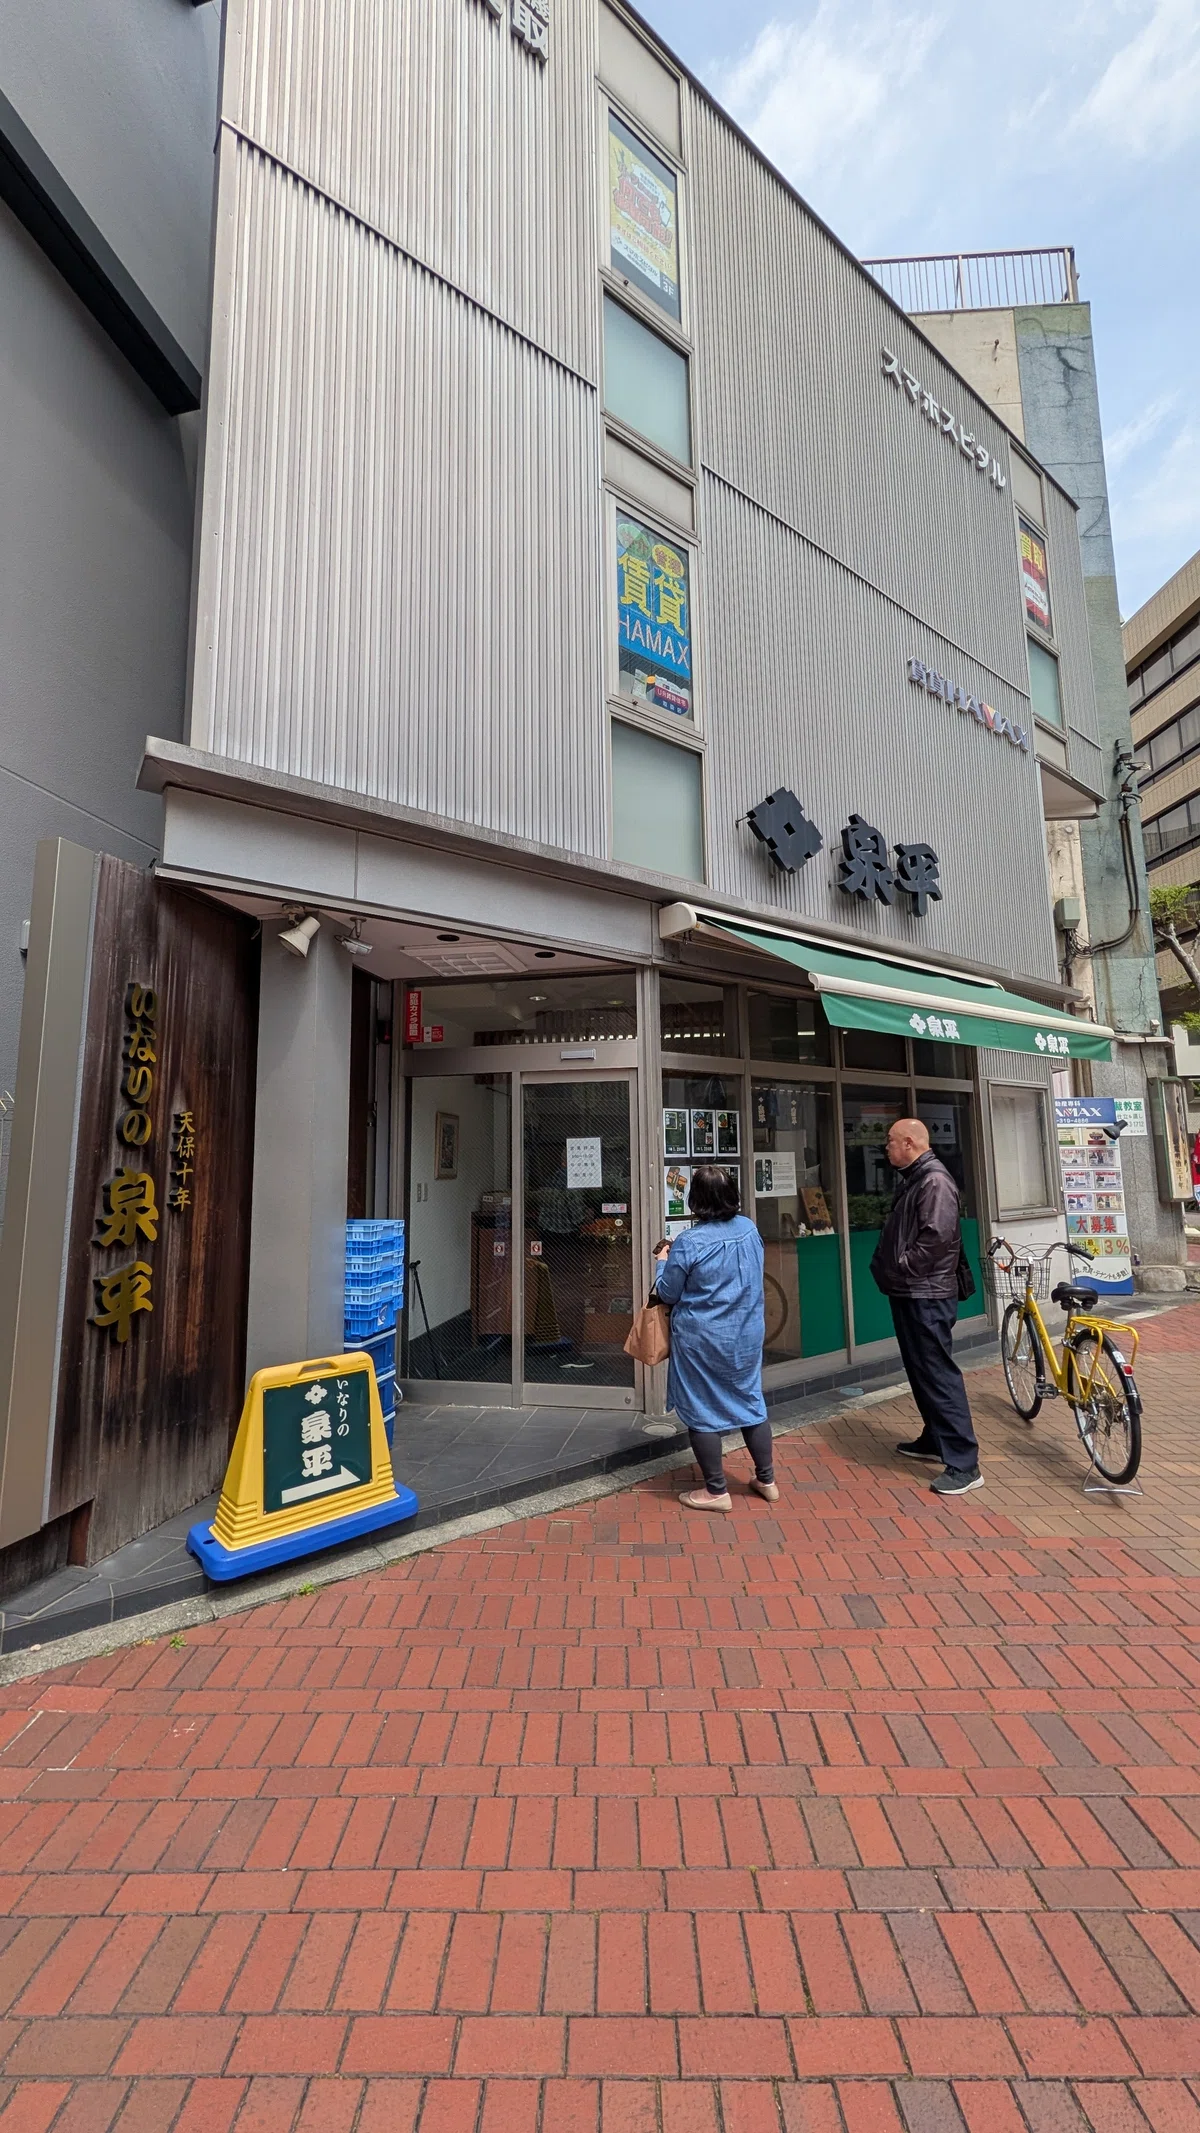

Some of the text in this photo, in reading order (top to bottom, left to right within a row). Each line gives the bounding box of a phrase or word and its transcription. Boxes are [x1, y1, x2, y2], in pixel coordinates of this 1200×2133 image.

[662, 281, 675, 296] 3F
[881, 346, 1006, 489] スマホスピタル
[618, 553, 686, 636] 賃貸
[618, 614, 690, 670] HAMAX
[838, 813, 942, 918] 泉平
[927, 1015, 961, 1040] 泉平
[1046, 1033, 1070, 1055] 泉平
[172, 1110, 196, 1212] 天保十年
[1076, 1215, 1117, 1234] 大募集
[1104, 1238, 1130, 1255] 3%
[336, 1379, 350, 1437] いなりの
[301, 1410, 334, 1478] 泉平
